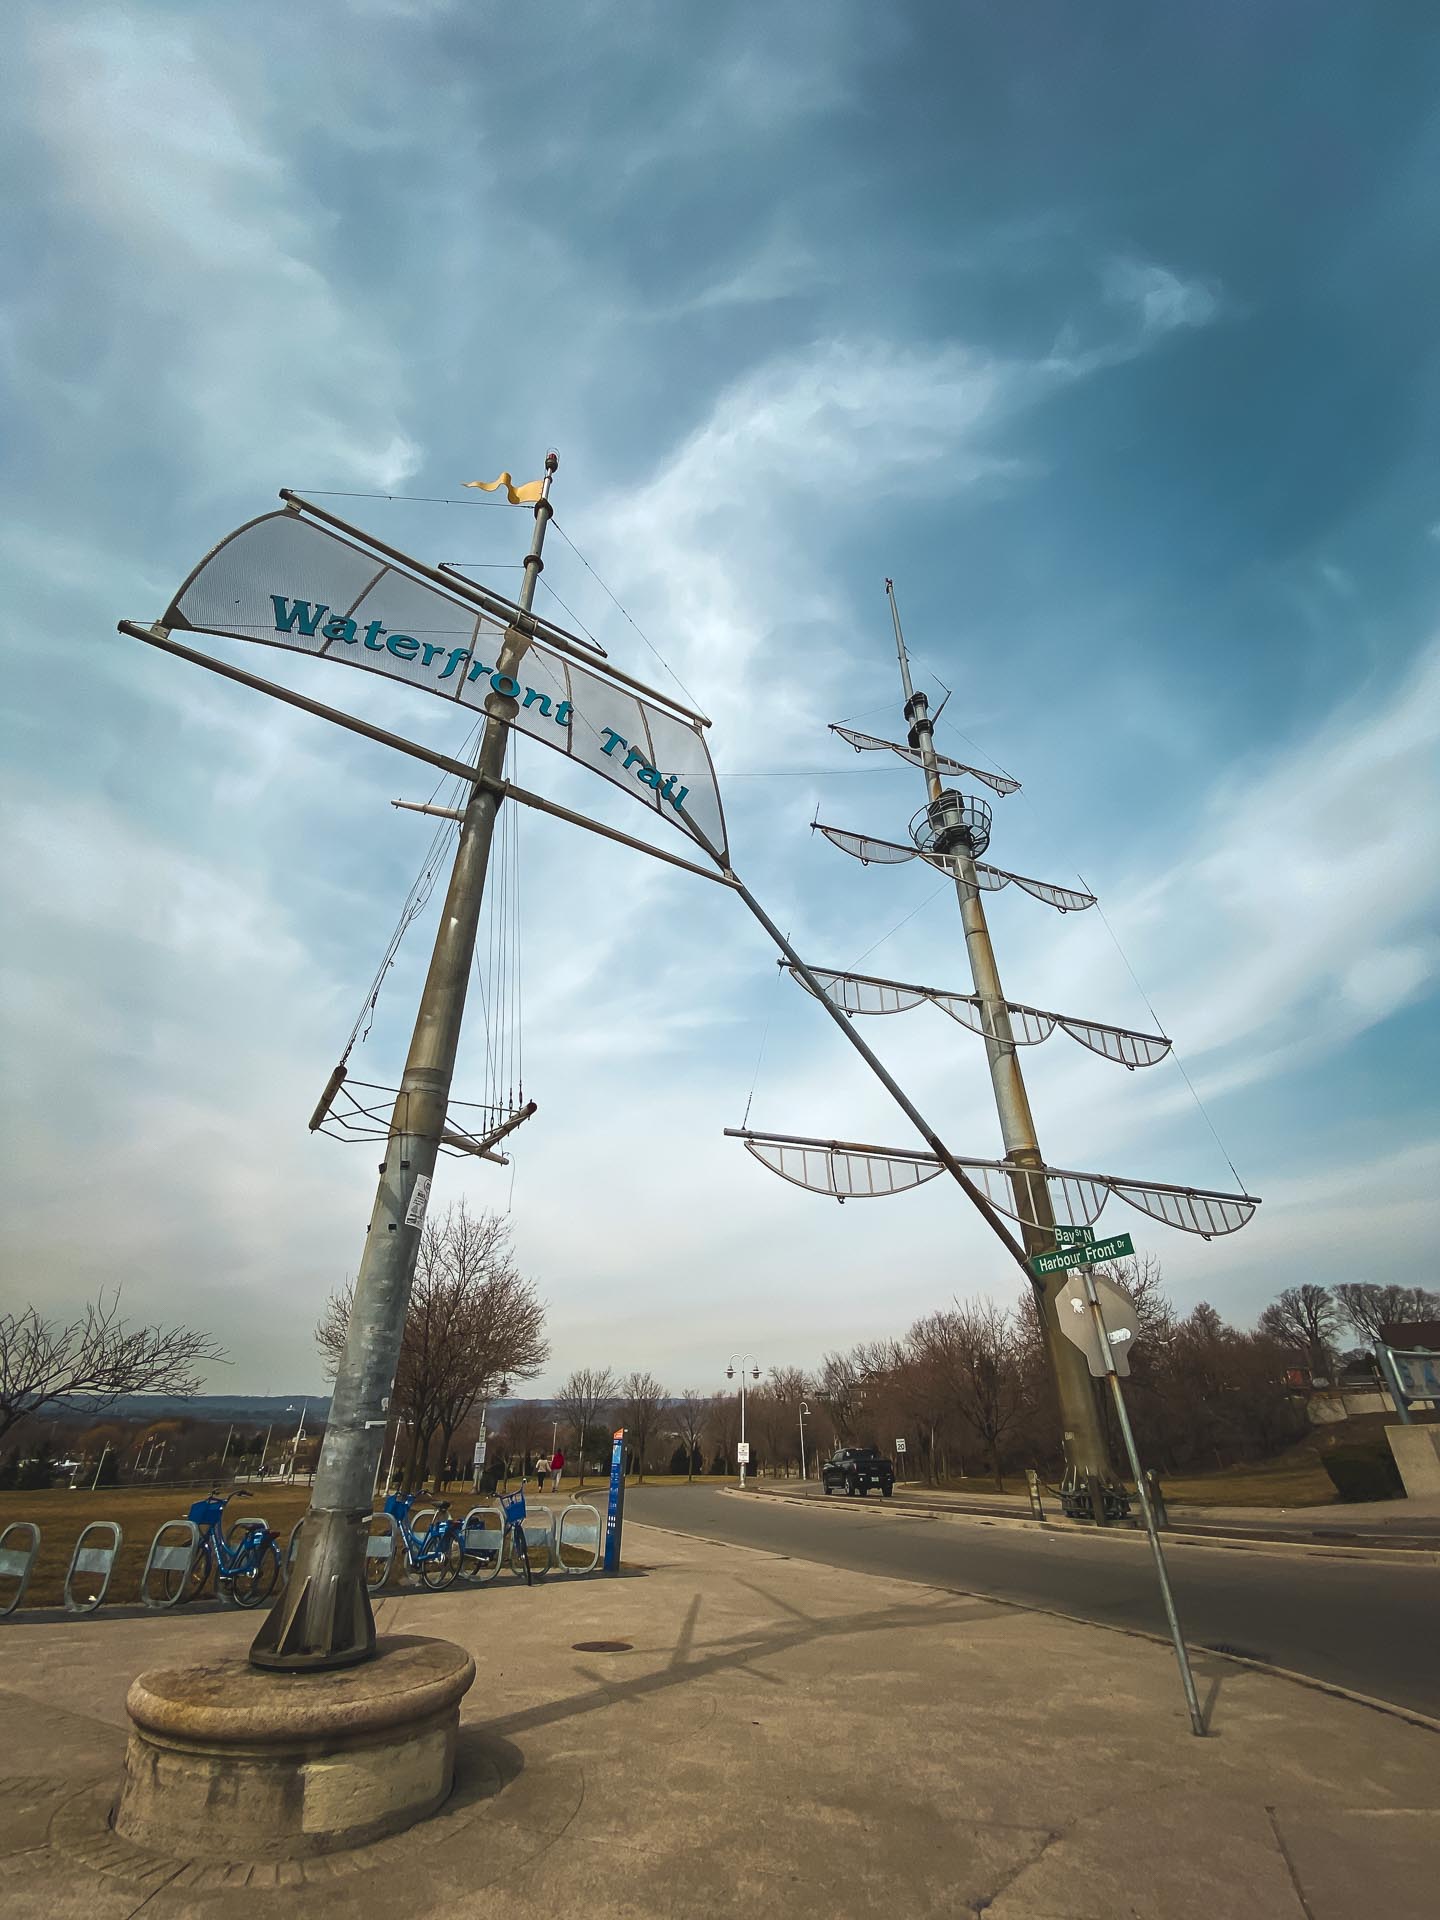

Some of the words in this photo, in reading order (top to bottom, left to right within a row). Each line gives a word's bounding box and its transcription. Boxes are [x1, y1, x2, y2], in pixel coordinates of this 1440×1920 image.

[270, 594, 574, 727] Waterfront
[600, 727, 689, 812] Trail
[1055, 1228, 1075, 1244] Bay
[1075, 1228, 1082, 1237] St
[1083, 1229, 1092, 1242] N
[1039, 1251, 1081, 1272] Harbour
[1085, 1242, 1117, 1261] Front
[1117, 1240, 1125, 1248] Dr
